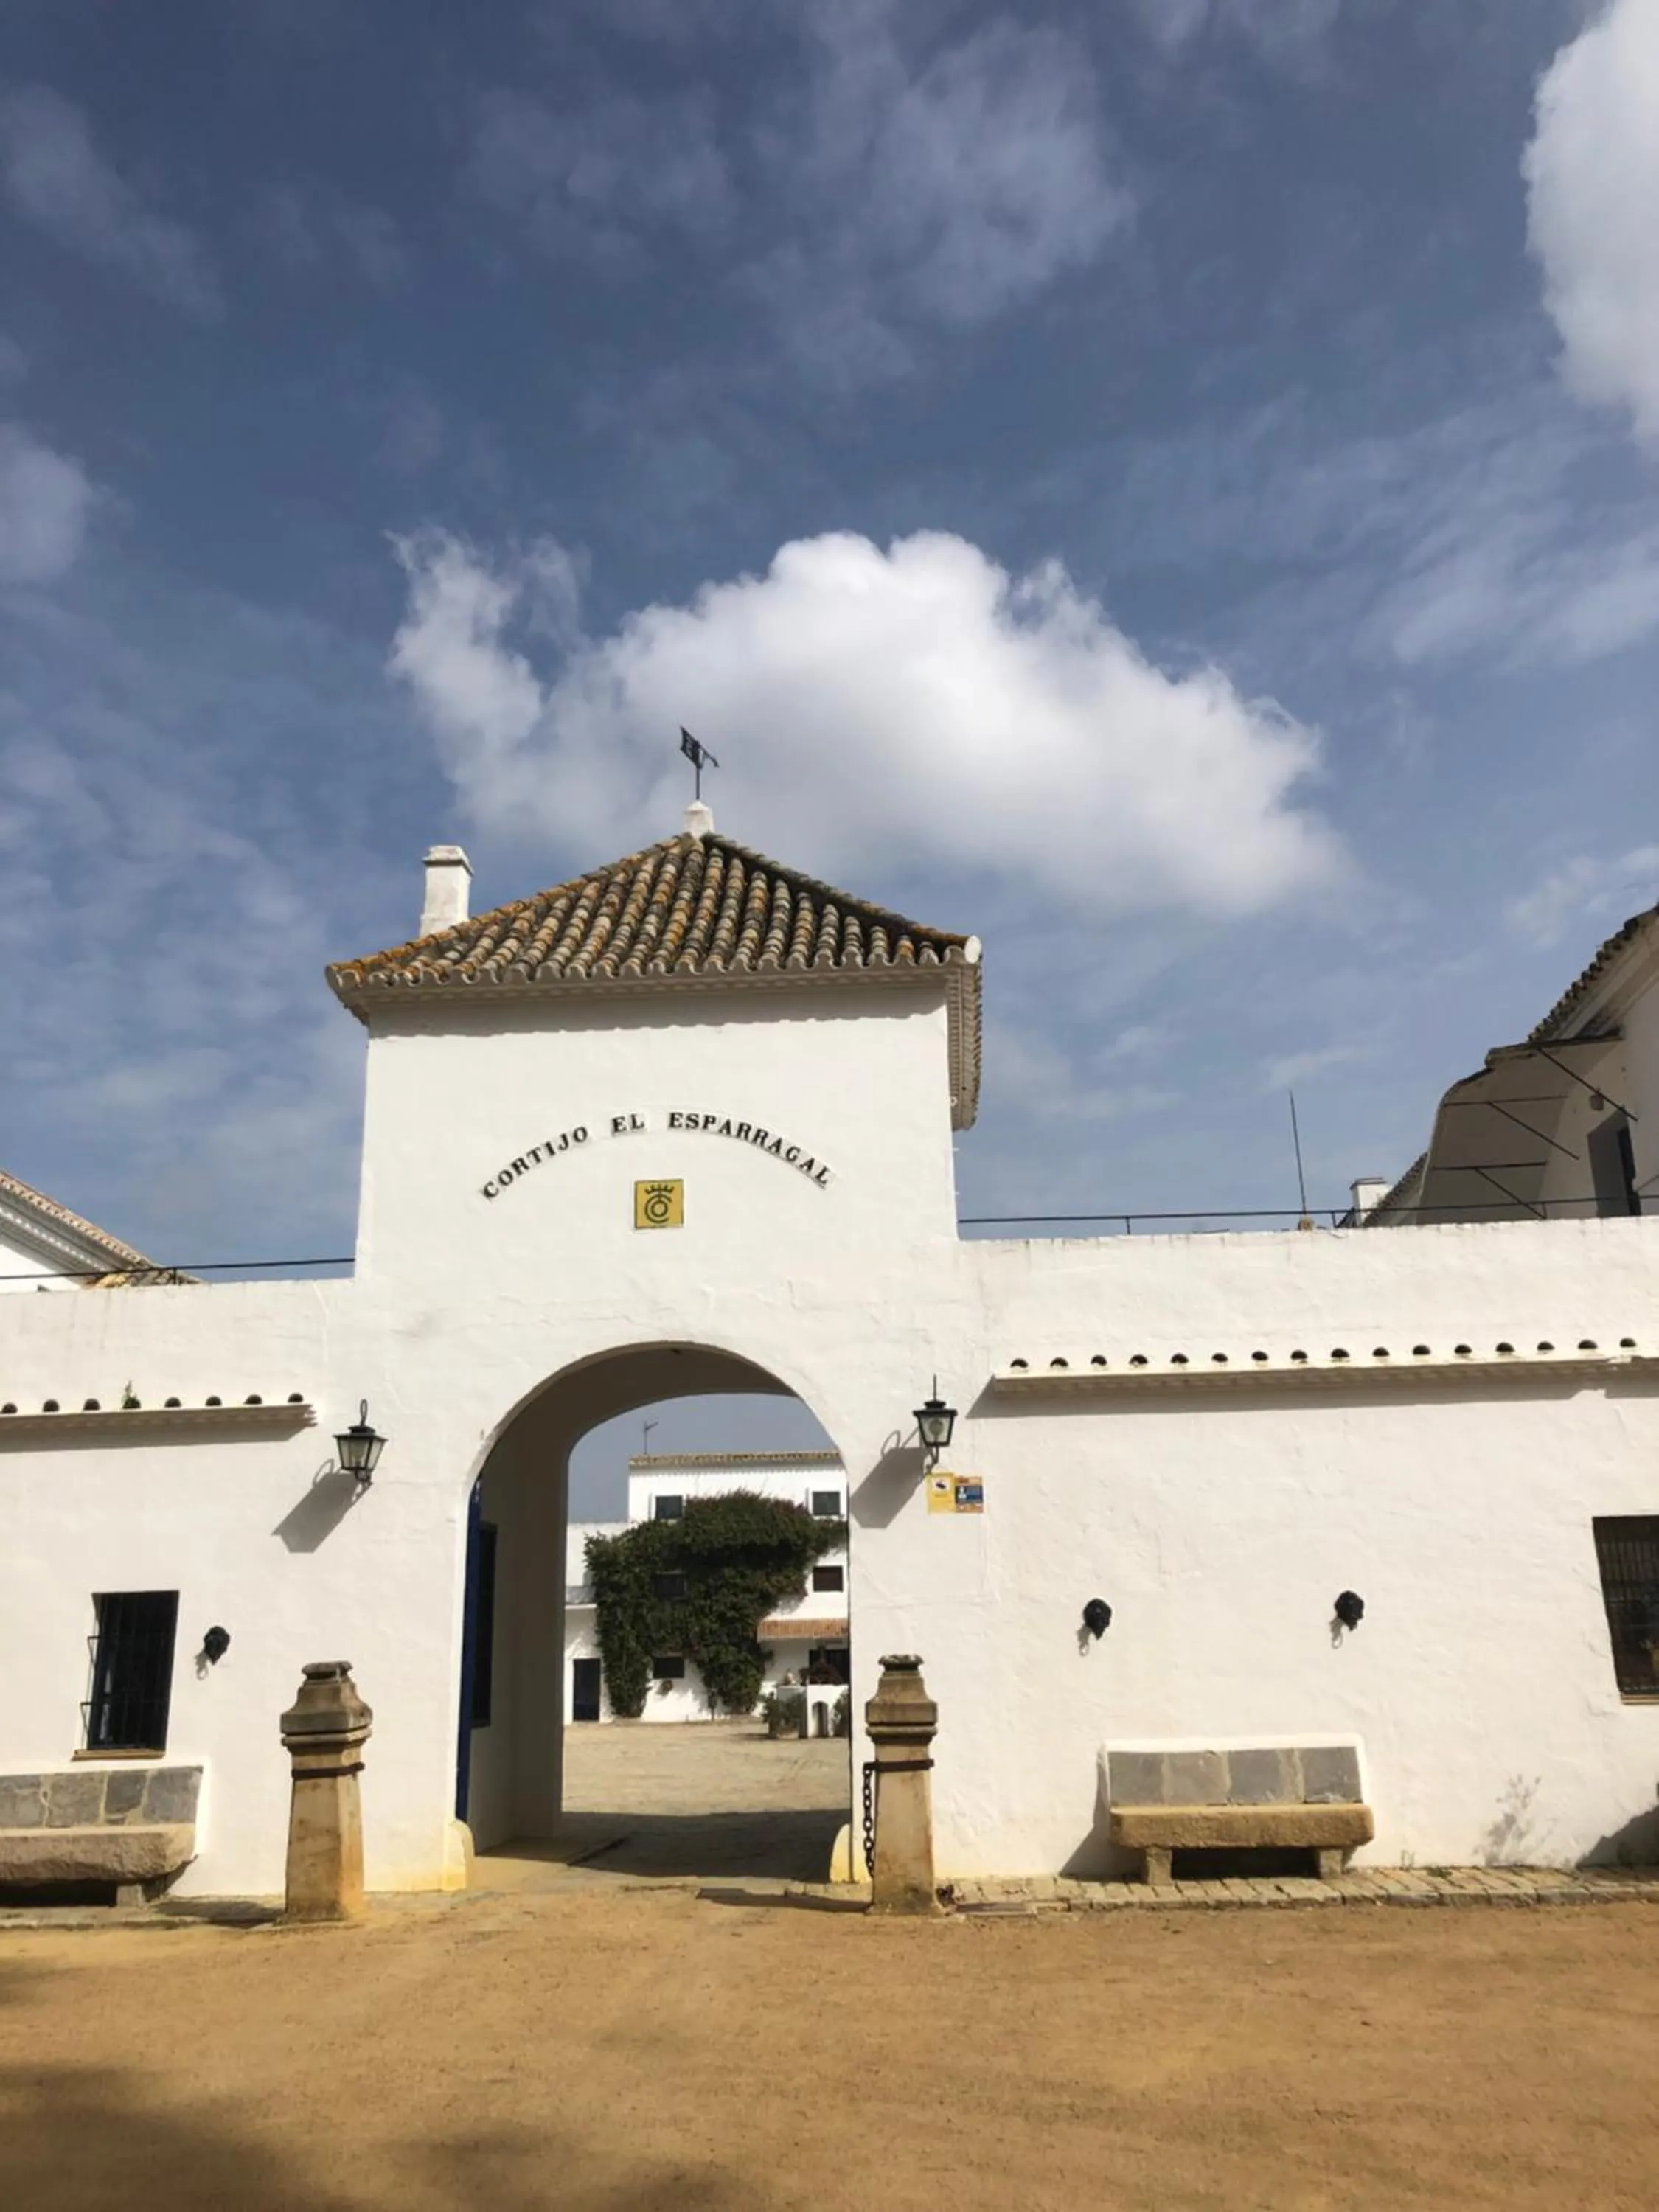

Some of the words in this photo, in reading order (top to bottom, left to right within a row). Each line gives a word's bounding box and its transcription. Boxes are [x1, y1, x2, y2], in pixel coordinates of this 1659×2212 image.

[482, 1126, 588, 1199] CORTIJO
[611, 1114, 644, 1134] EL
[668, 1112, 829, 1185] ESPARRAGAL
